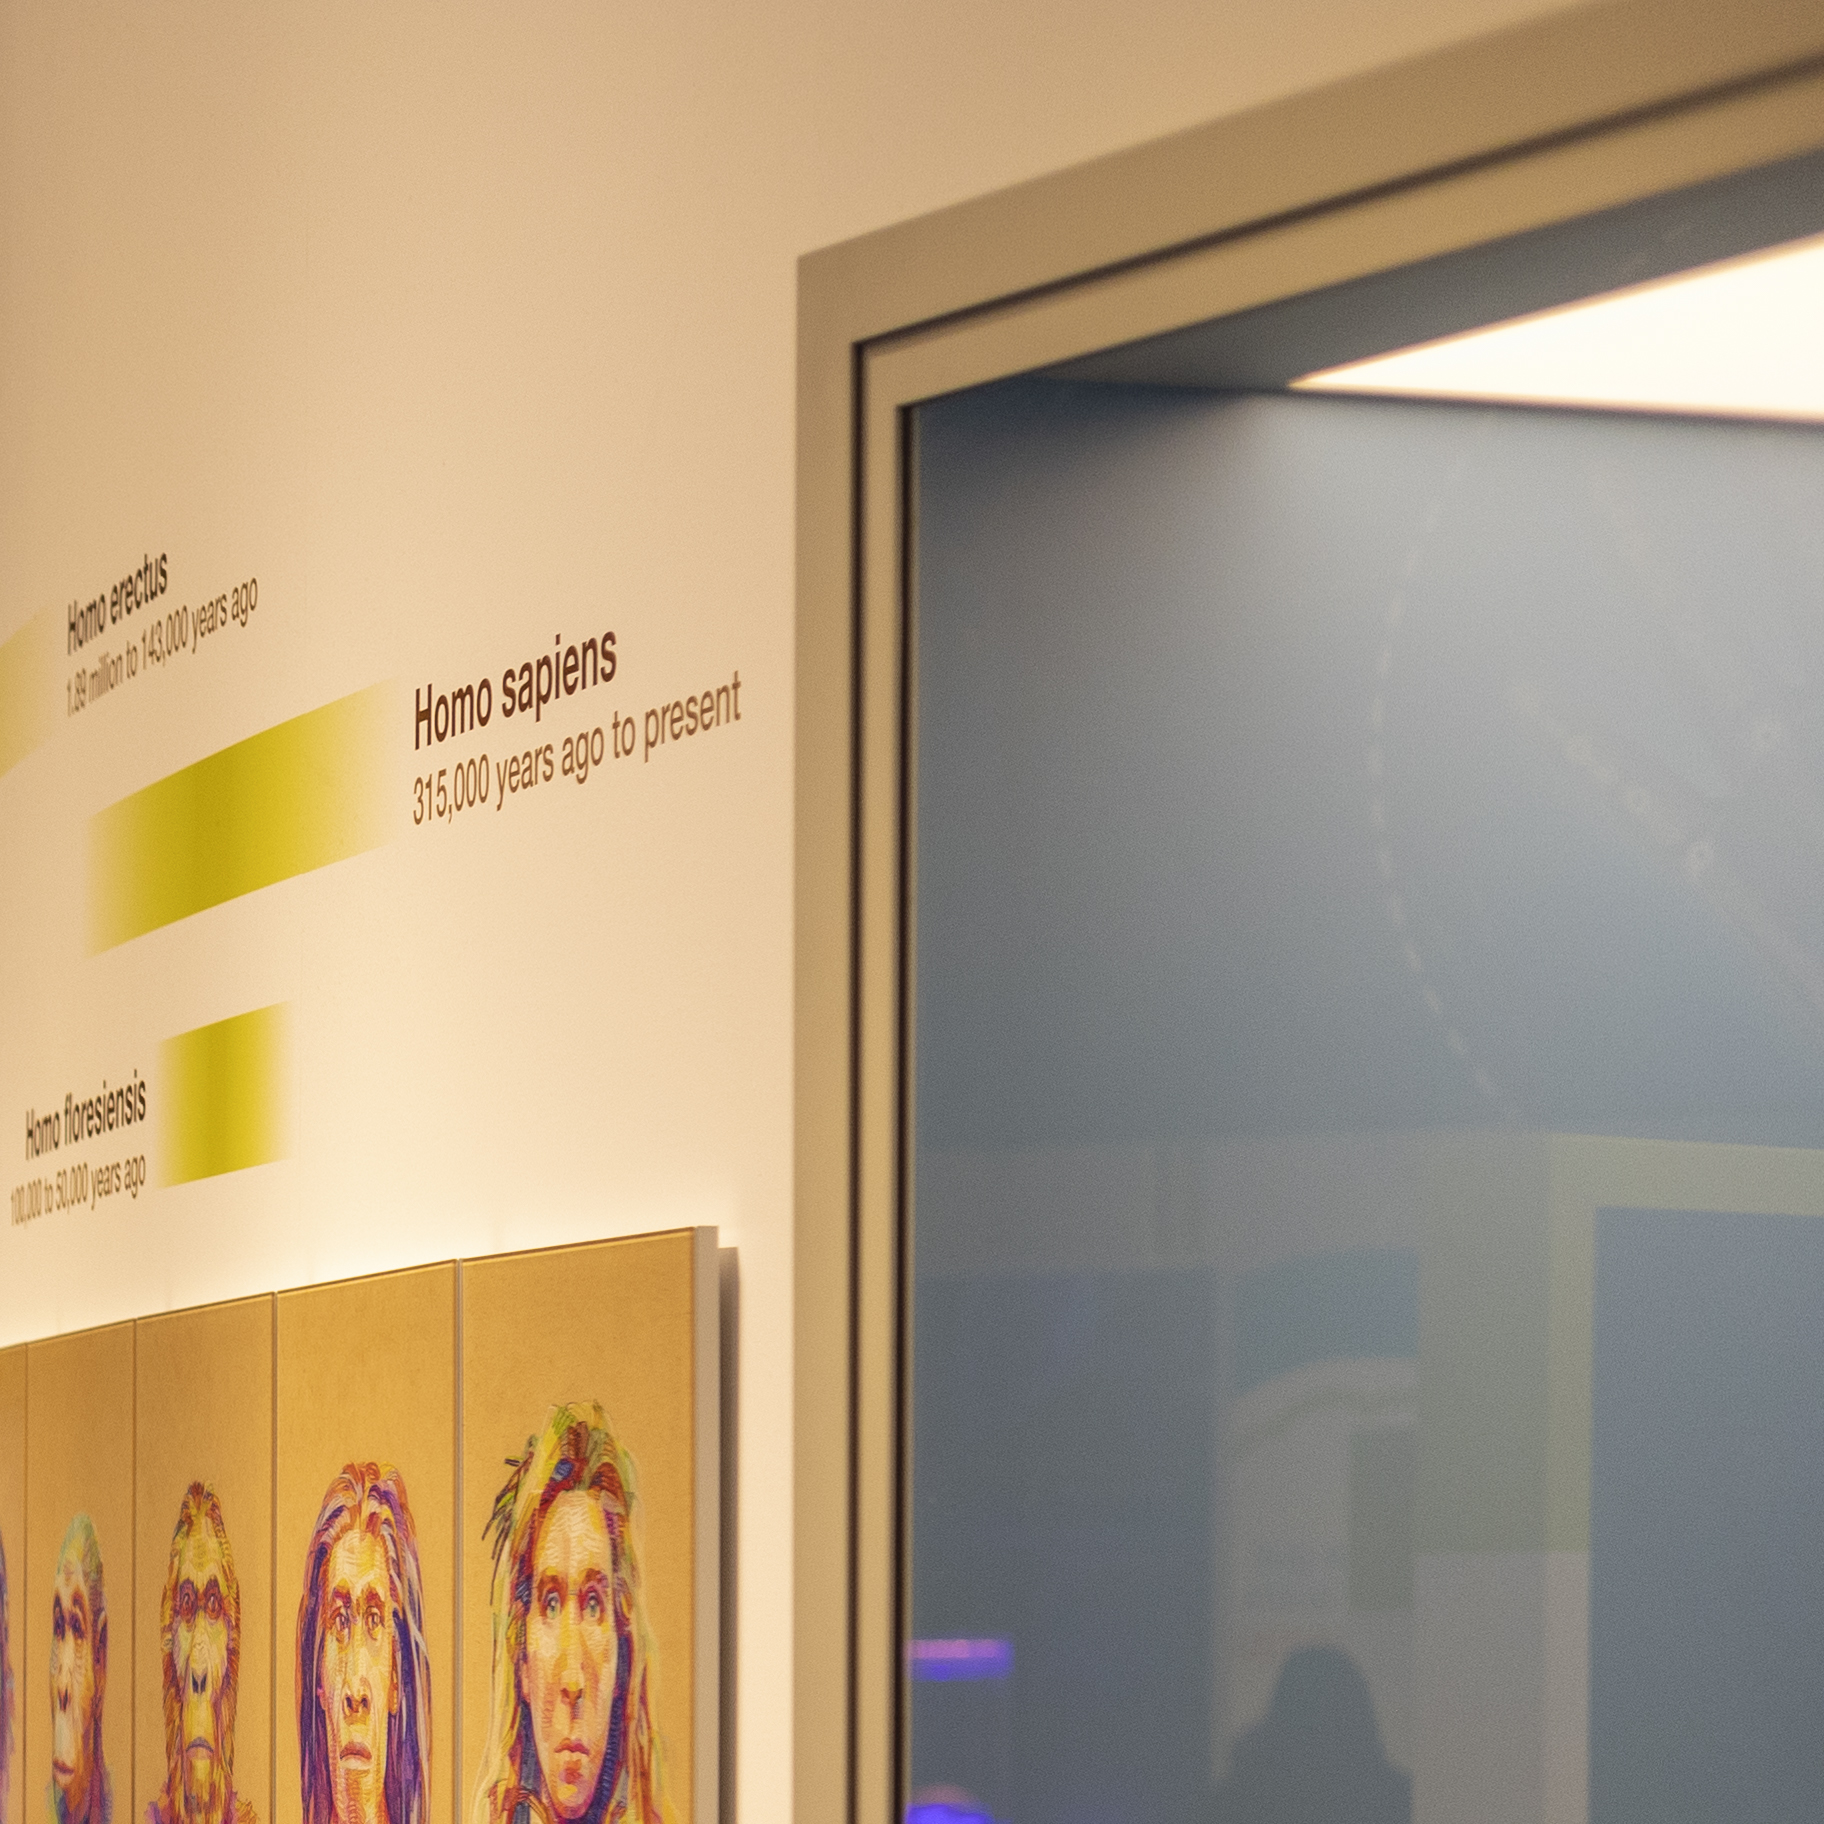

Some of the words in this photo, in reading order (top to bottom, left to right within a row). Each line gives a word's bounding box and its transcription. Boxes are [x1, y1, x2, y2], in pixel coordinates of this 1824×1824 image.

[67, 594, 106, 656] Homo
[110, 552, 167, 625] erectus
[88, 652, 123, 703] million
[125, 640, 138, 680] to
[141, 605, 188, 670] 143,000
[191, 593, 227, 655] years
[231, 577, 258, 628] ago
[414, 678, 492, 751] Homo
[502, 630, 617, 723] sapiens
[413, 753, 490, 826] 315,000
[496, 743, 554, 812] years
[561, 727, 605, 785] ago
[612, 710, 636, 759] to
[644, 670, 742, 764] present
[25, 1108, 60, 1161] Homo
[64, 1068, 146, 1146] floresiensis
[56, 1162, 88, 1214] 50,000
[91, 1161, 121, 1211] years
[124, 1154, 146, 1199] ago
